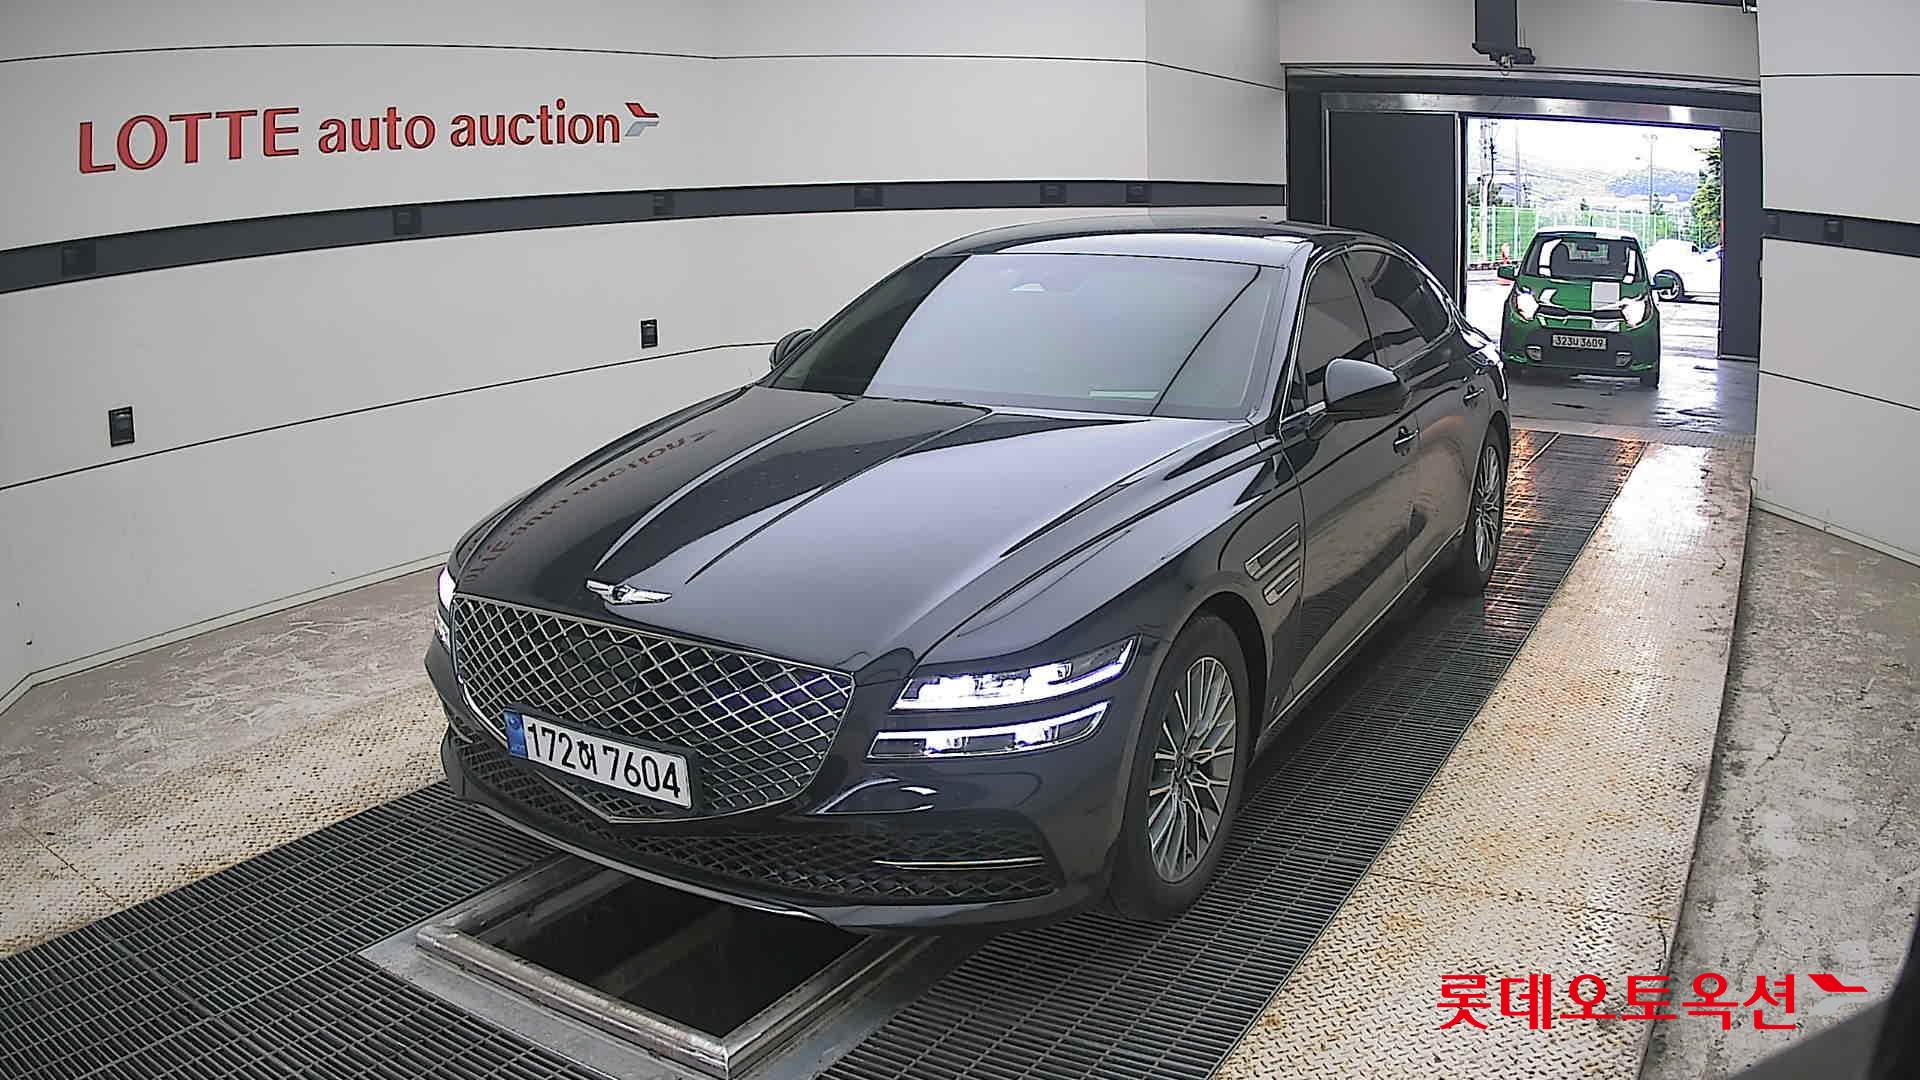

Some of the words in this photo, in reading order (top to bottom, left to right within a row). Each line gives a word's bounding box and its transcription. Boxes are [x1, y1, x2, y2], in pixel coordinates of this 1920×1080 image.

[79, 107, 299, 175] LOTTE
[318, 106, 436, 153] auto
[450, 98, 621, 146] auction
[602, 745, 681, 799] 7604
